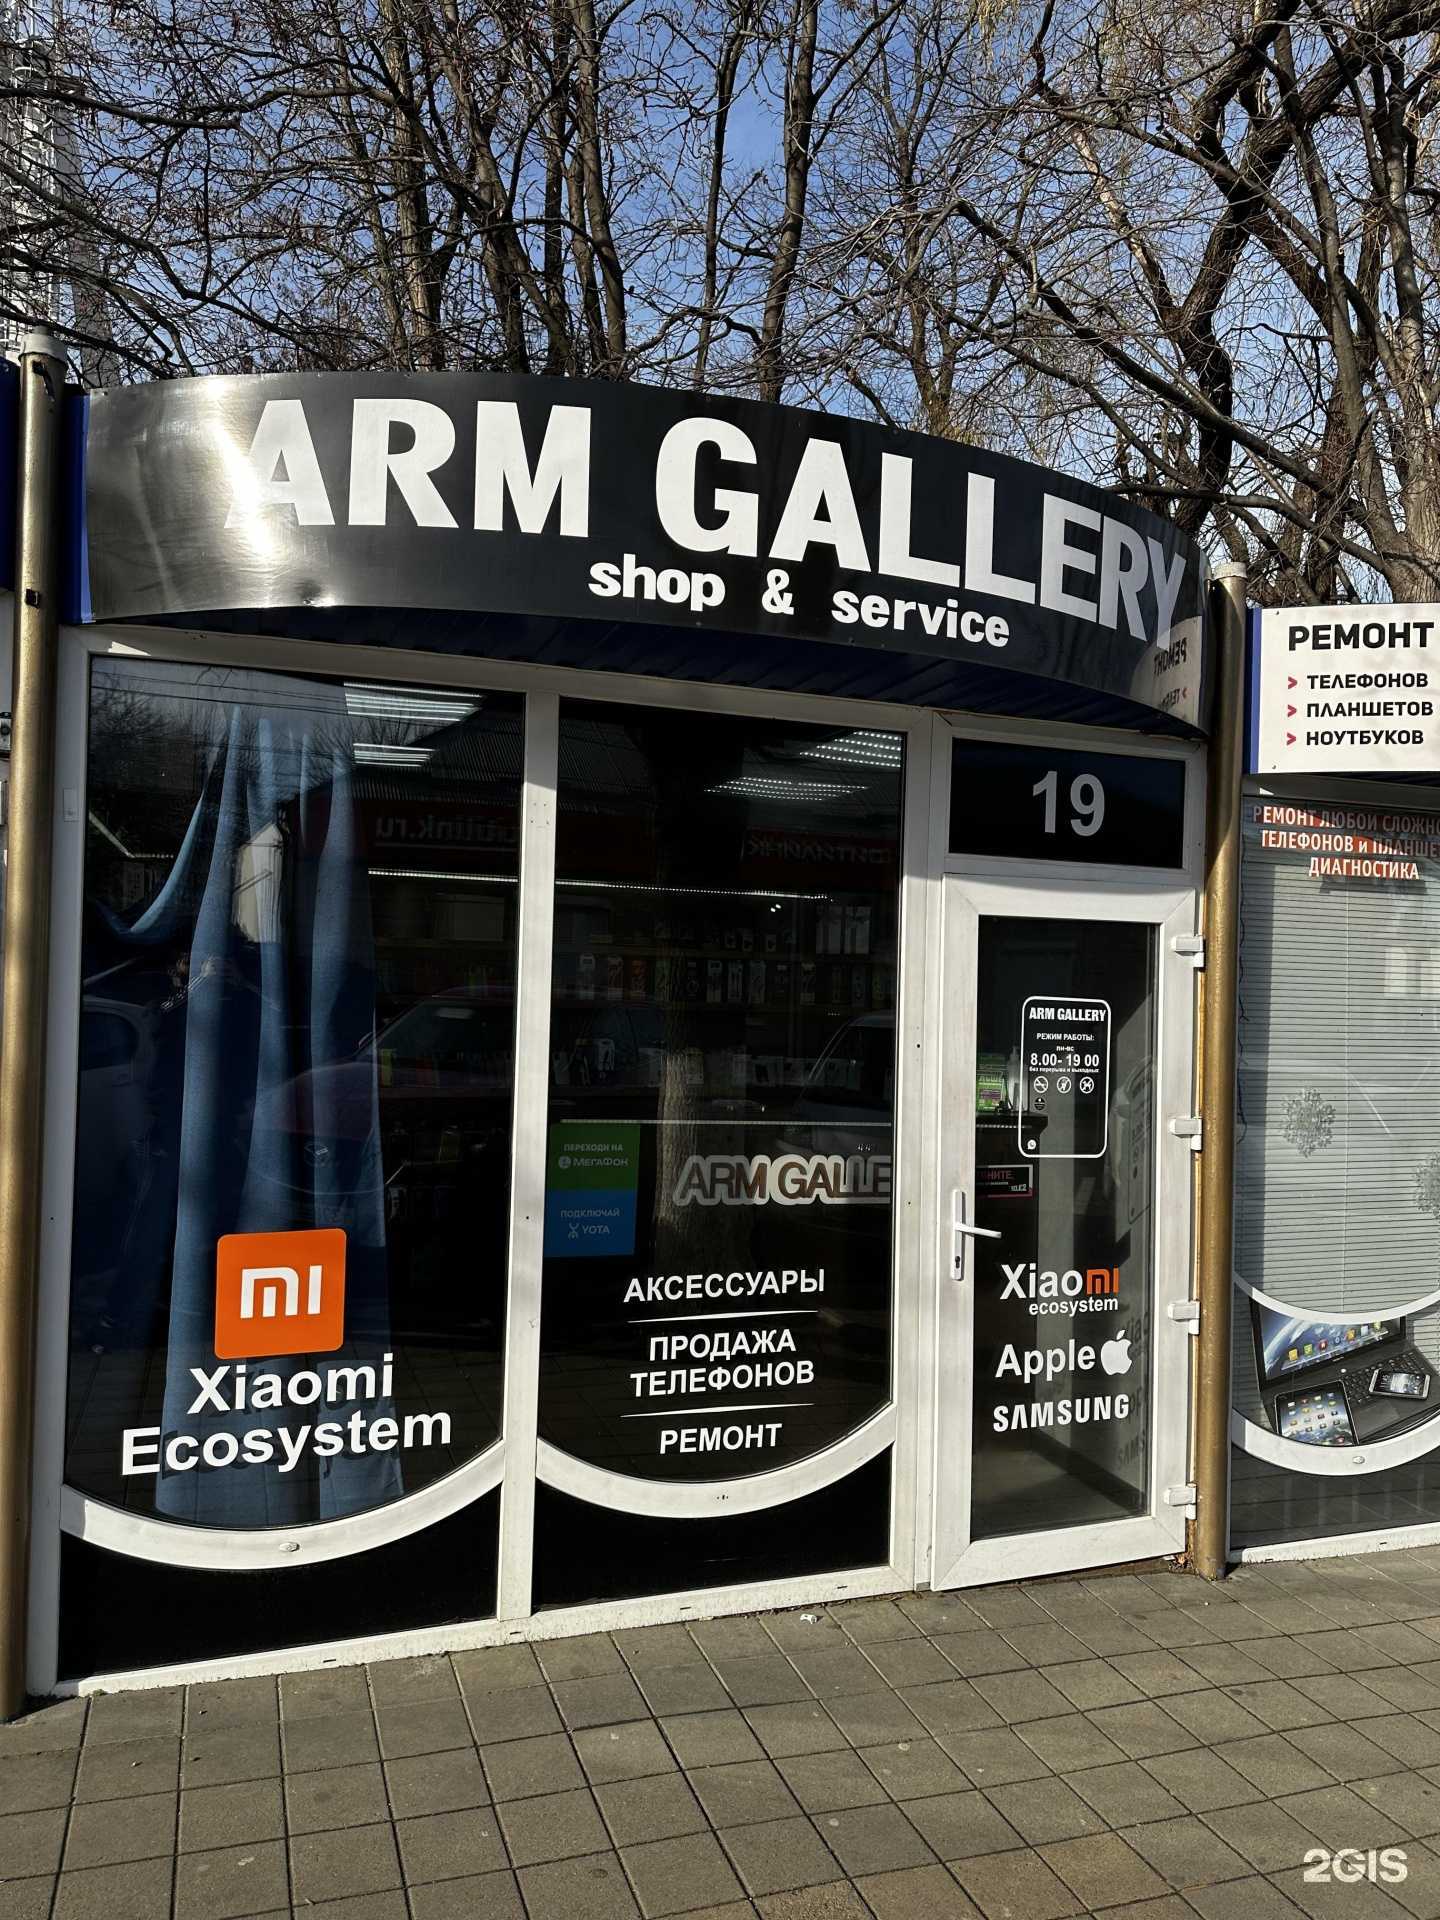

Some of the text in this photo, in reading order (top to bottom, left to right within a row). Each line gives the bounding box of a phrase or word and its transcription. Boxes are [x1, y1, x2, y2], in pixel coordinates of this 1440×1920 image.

[224, 398, 1187, 651] ARM GALLERY
[588, 554, 1010, 648] shop & service
[1288, 621, 1435, 652] РЕМОНТ
[1307, 672, 1429, 690] ТЕЛЕФОНОВ
[1306, 701, 1434, 718] ПЛАНШЕТОВ
[1306, 730, 1425, 746] НОУТБУКОВ
[1033, 770, 1105, 837] 19
[1253, 806, 1318, 828] РЕМОНТ
[1261, 829, 1354, 852] ТЕЛЕФОНОВ
[1372, 836, 1440, 859] ПЛАНШЕ
[1309, 857, 1420, 880] ДИАГНОСТИКА
[1029, 1007, 1106, 1022] ARM GALLERY
[1036, 1032, 1062, 1041] РЕЖИМ
[573, 1158, 629, 1167] МЕГАФОН
[676, 1157, 768, 1204] ARM
[583, 1225, 610, 1235] YOTA
[623, 1268, 825, 1303] АКСЕССУАРЫ
[1028, 1296, 1119, 1317] ecosystem
[649, 1329, 797, 1362] ПРОДАЖА
[995, 1338, 1096, 1384] Apple
[187, 1353, 394, 1415] Xiaomi
[630, 1360, 815, 1397] ТЕЛЕФОНОВ
[993, 1393, 1130, 1432] SAMSUNG
[122, 1409, 452, 1476] Ecosystem
[659, 1423, 783, 1454] РЕМОНТ
